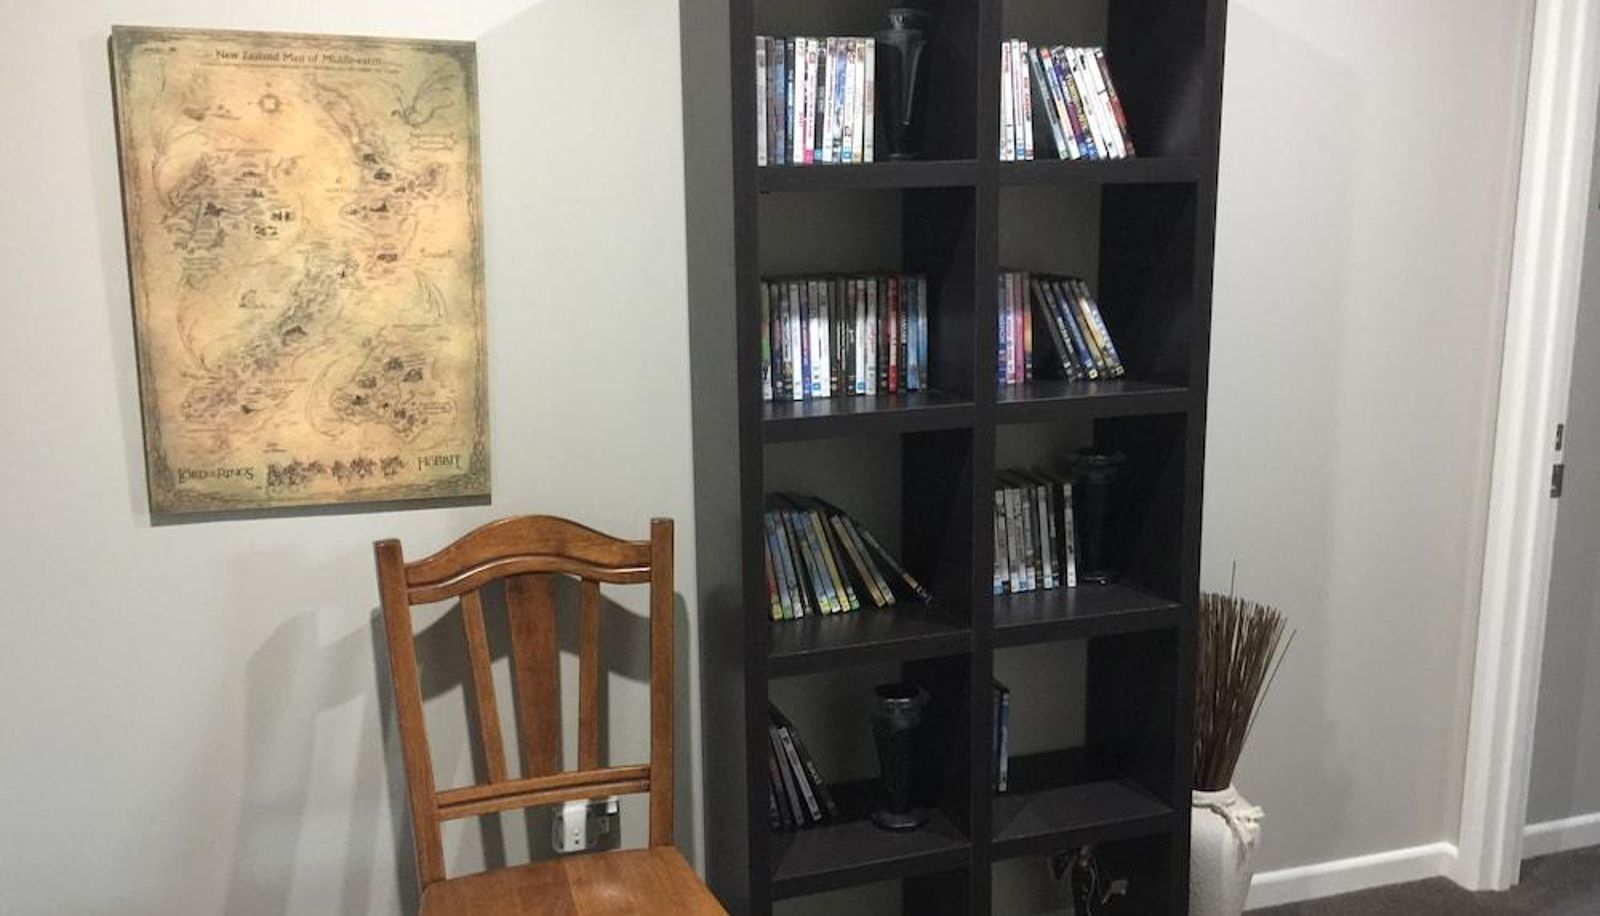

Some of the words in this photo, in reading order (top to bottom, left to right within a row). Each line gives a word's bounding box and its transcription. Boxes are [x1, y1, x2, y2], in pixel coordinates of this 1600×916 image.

[215, 49, 238, 60] New
[242, 50, 280, 62] Zealand
[308, 53, 319, 64] of
